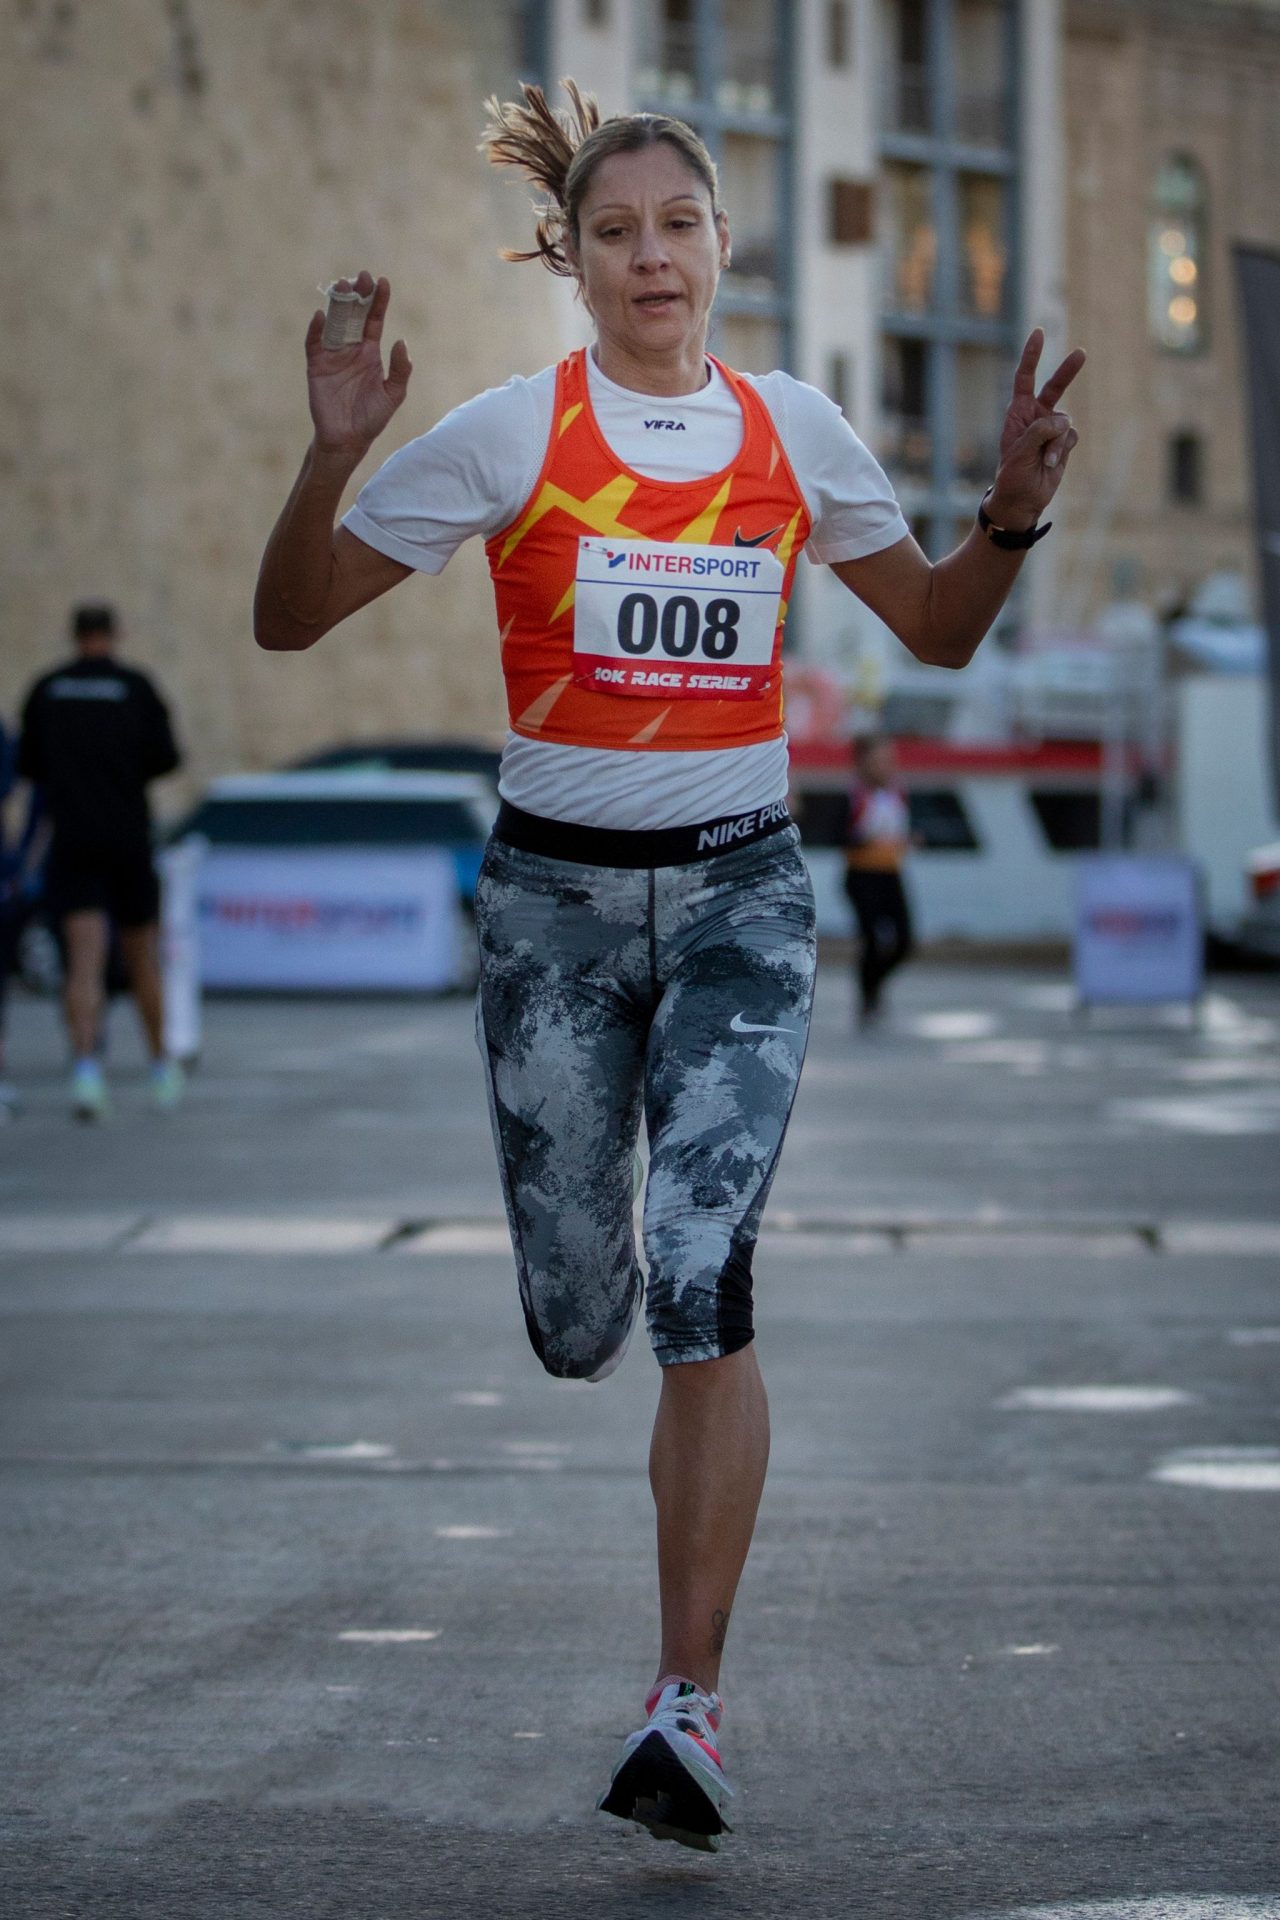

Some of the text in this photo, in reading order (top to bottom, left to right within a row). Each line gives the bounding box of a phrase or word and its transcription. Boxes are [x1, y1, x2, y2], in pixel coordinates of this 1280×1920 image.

[643, 419, 686, 431] VIFRA
[628, 552, 761, 578] INTERSPORT
[617, 592, 741, 660] 008
[595, 667, 752, 691] 10K RACE SERIES
[697, 813, 757, 851] NIKE
